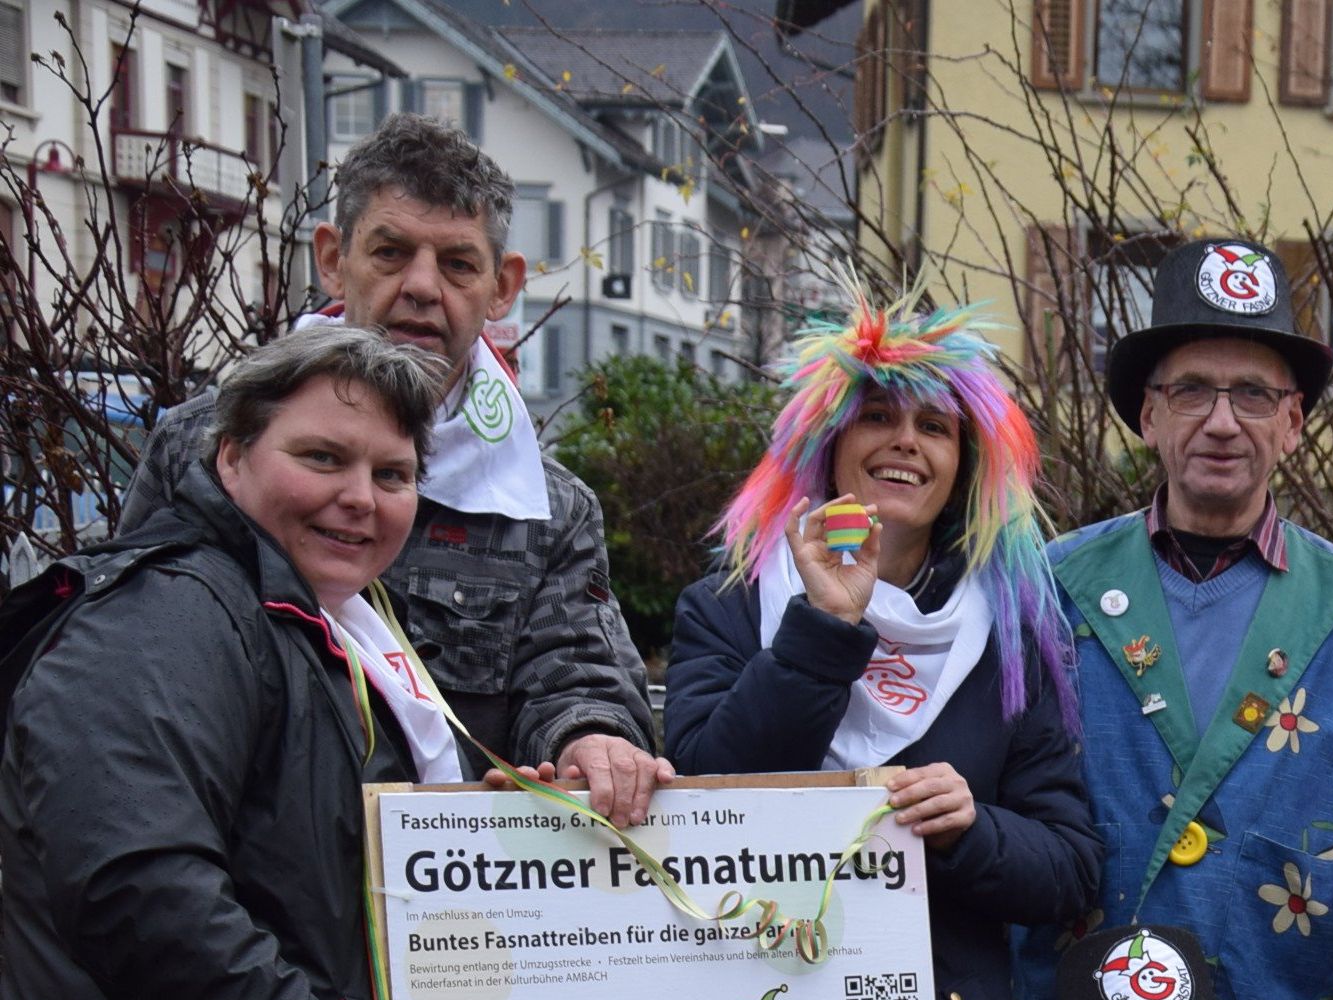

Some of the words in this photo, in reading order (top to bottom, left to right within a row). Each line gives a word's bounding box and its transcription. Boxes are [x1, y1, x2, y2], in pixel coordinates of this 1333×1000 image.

[401, 813, 566, 833] Faschingssamstag,
[570, 812, 586, 828] 6.
[661, 812, 687, 827] um
[691, 810, 711, 826] 14
[715, 808, 746, 825] Uhr
[405, 848, 596, 892] Götzner
[608, 846, 906, 890] Fasnatumzug
[406, 911, 418, 921] Im
[422, 909, 469, 921] Anschluss
[471, 911, 484, 920] an
[486, 909, 504, 919] den
[506, 908, 544, 920] Umzug:
[409, 933, 479, 952] Buntes
[485, 927, 622, 949] Fasnattreiben
[626, 925, 654, 943] für
[660, 924, 689, 942] die
[410, 963, 461, 975] Bewirtung
[462, 961, 500, 973] entlang
[502, 960, 517, 971] der
[520, 957, 592, 971] Umzugsstrecke
[608, 954, 643, 966] Festzelt
[645, 954, 668, 964] beim
[669, 951, 724, 963] Vereinshaus
[726, 951, 744, 961] und
[746, 949, 769, 960] beim
[771, 948, 794, 959] alten
[411, 978, 472, 990] Kinderfasnat
[474, 978, 484, 988] in
[486, 975, 502, 987] der
[504, 973, 563, 986] Kulturbühne
[566, 971, 608, 983] AMBACH
